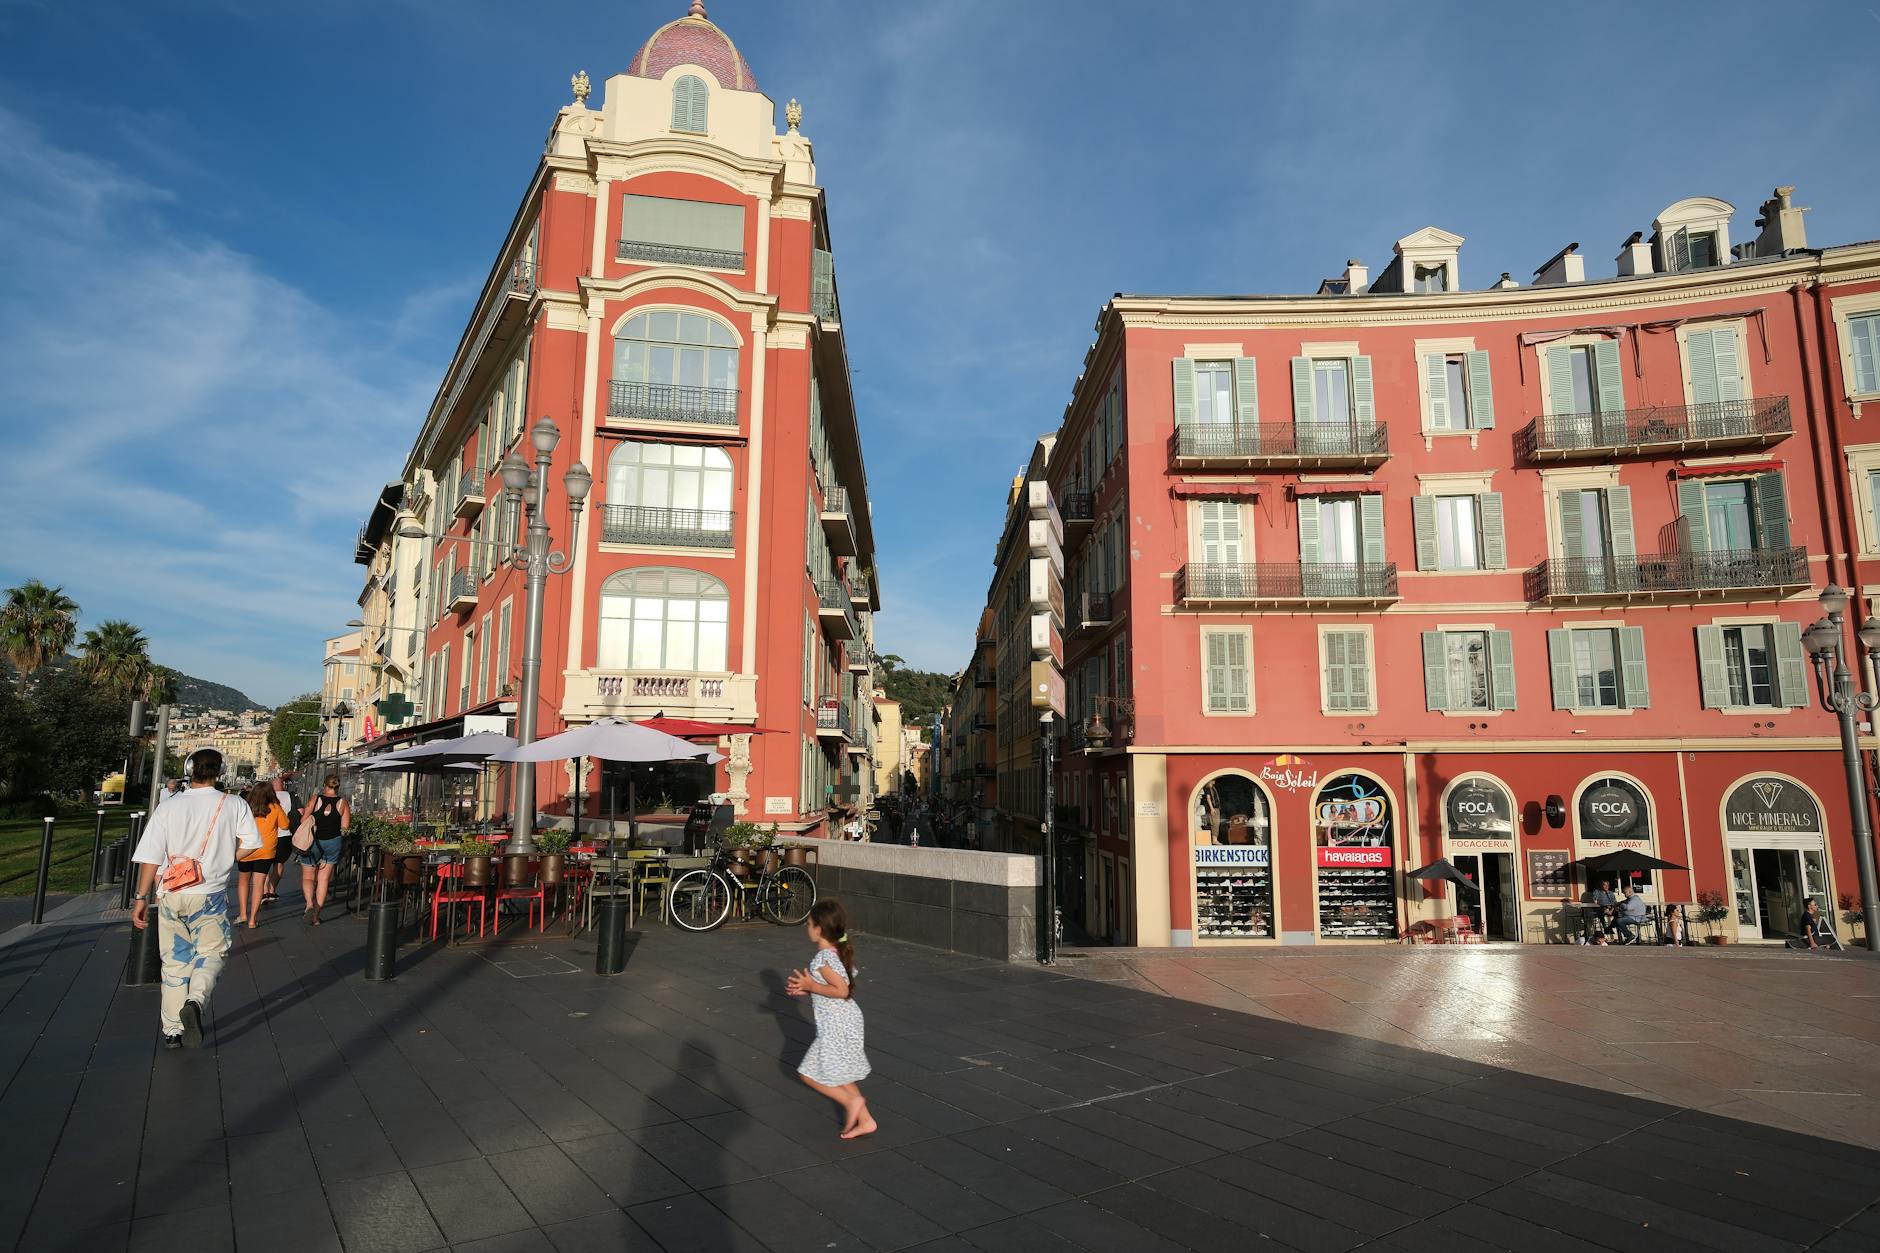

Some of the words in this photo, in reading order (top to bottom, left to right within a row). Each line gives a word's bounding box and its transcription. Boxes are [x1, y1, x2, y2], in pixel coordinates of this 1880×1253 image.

[1690, 753, 1695, 761] 8
[1260, 766, 1285, 779] Bain
[1274, 769, 1318, 788] Soleil
[1458, 802, 1496, 813] FOCA
[1591, 802, 1631, 814] FOCA
[1732, 812, 1756, 825] NICE
[1759, 812, 1811, 827] MINERALS
[1451, 840, 1509, 848] FOCACCERIA
[1588, 840, 1611, 848] TAKE
[1617, 841, 1643, 849] AWAY
[1195, 849, 1268, 862] BIRKENSTOCK
[1325, 850, 1383, 863] havaianas
